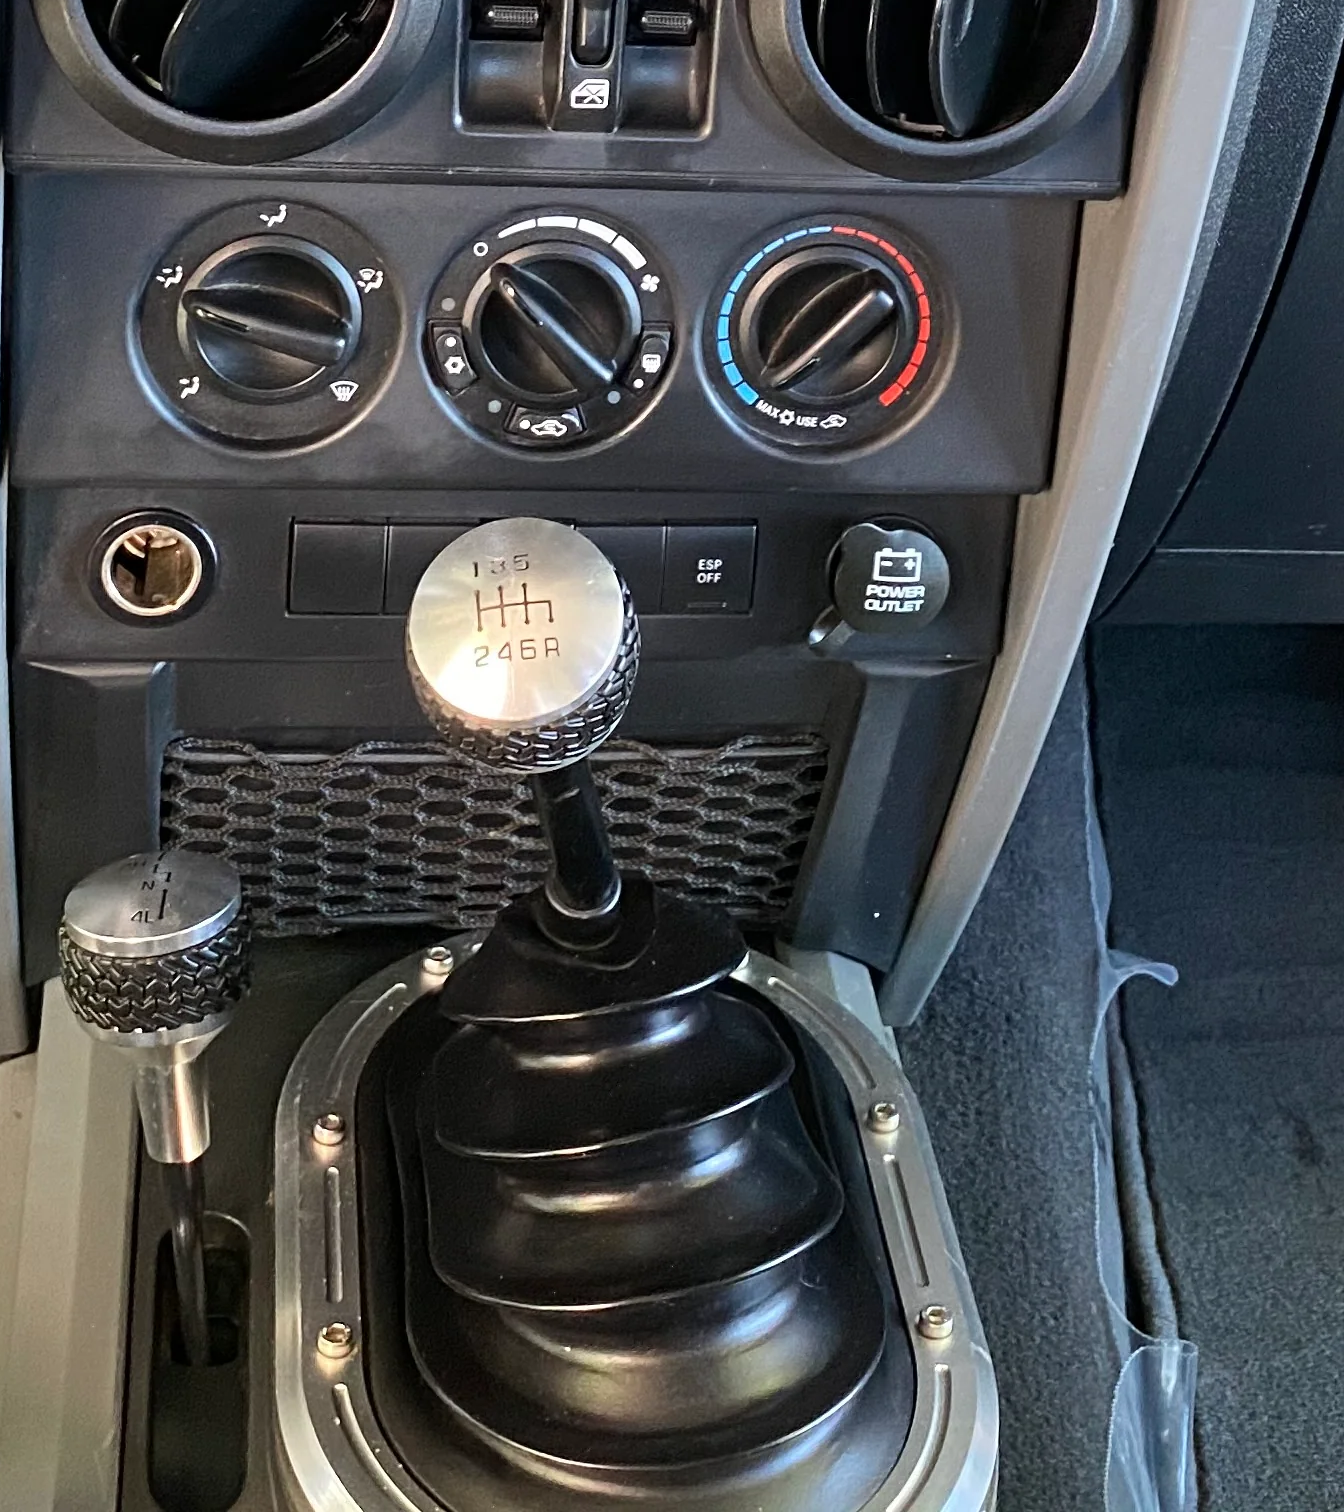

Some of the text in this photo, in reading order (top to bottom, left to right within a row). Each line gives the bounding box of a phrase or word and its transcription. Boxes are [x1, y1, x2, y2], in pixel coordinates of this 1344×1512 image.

[756, 400, 818, 428] MAX USE
[513, 554, 529, 571] 5
[699, 559, 722, 570] ESP
[697, 573, 721, 583] OFF
[866, 584, 926, 598] POWER
[864, 599, 924, 612] OUTLET
[498, 642, 512, 661] 4
[520, 639, 536, 660] 6
[141, 880, 155, 890] N
[130, 910, 154, 923] 4L
